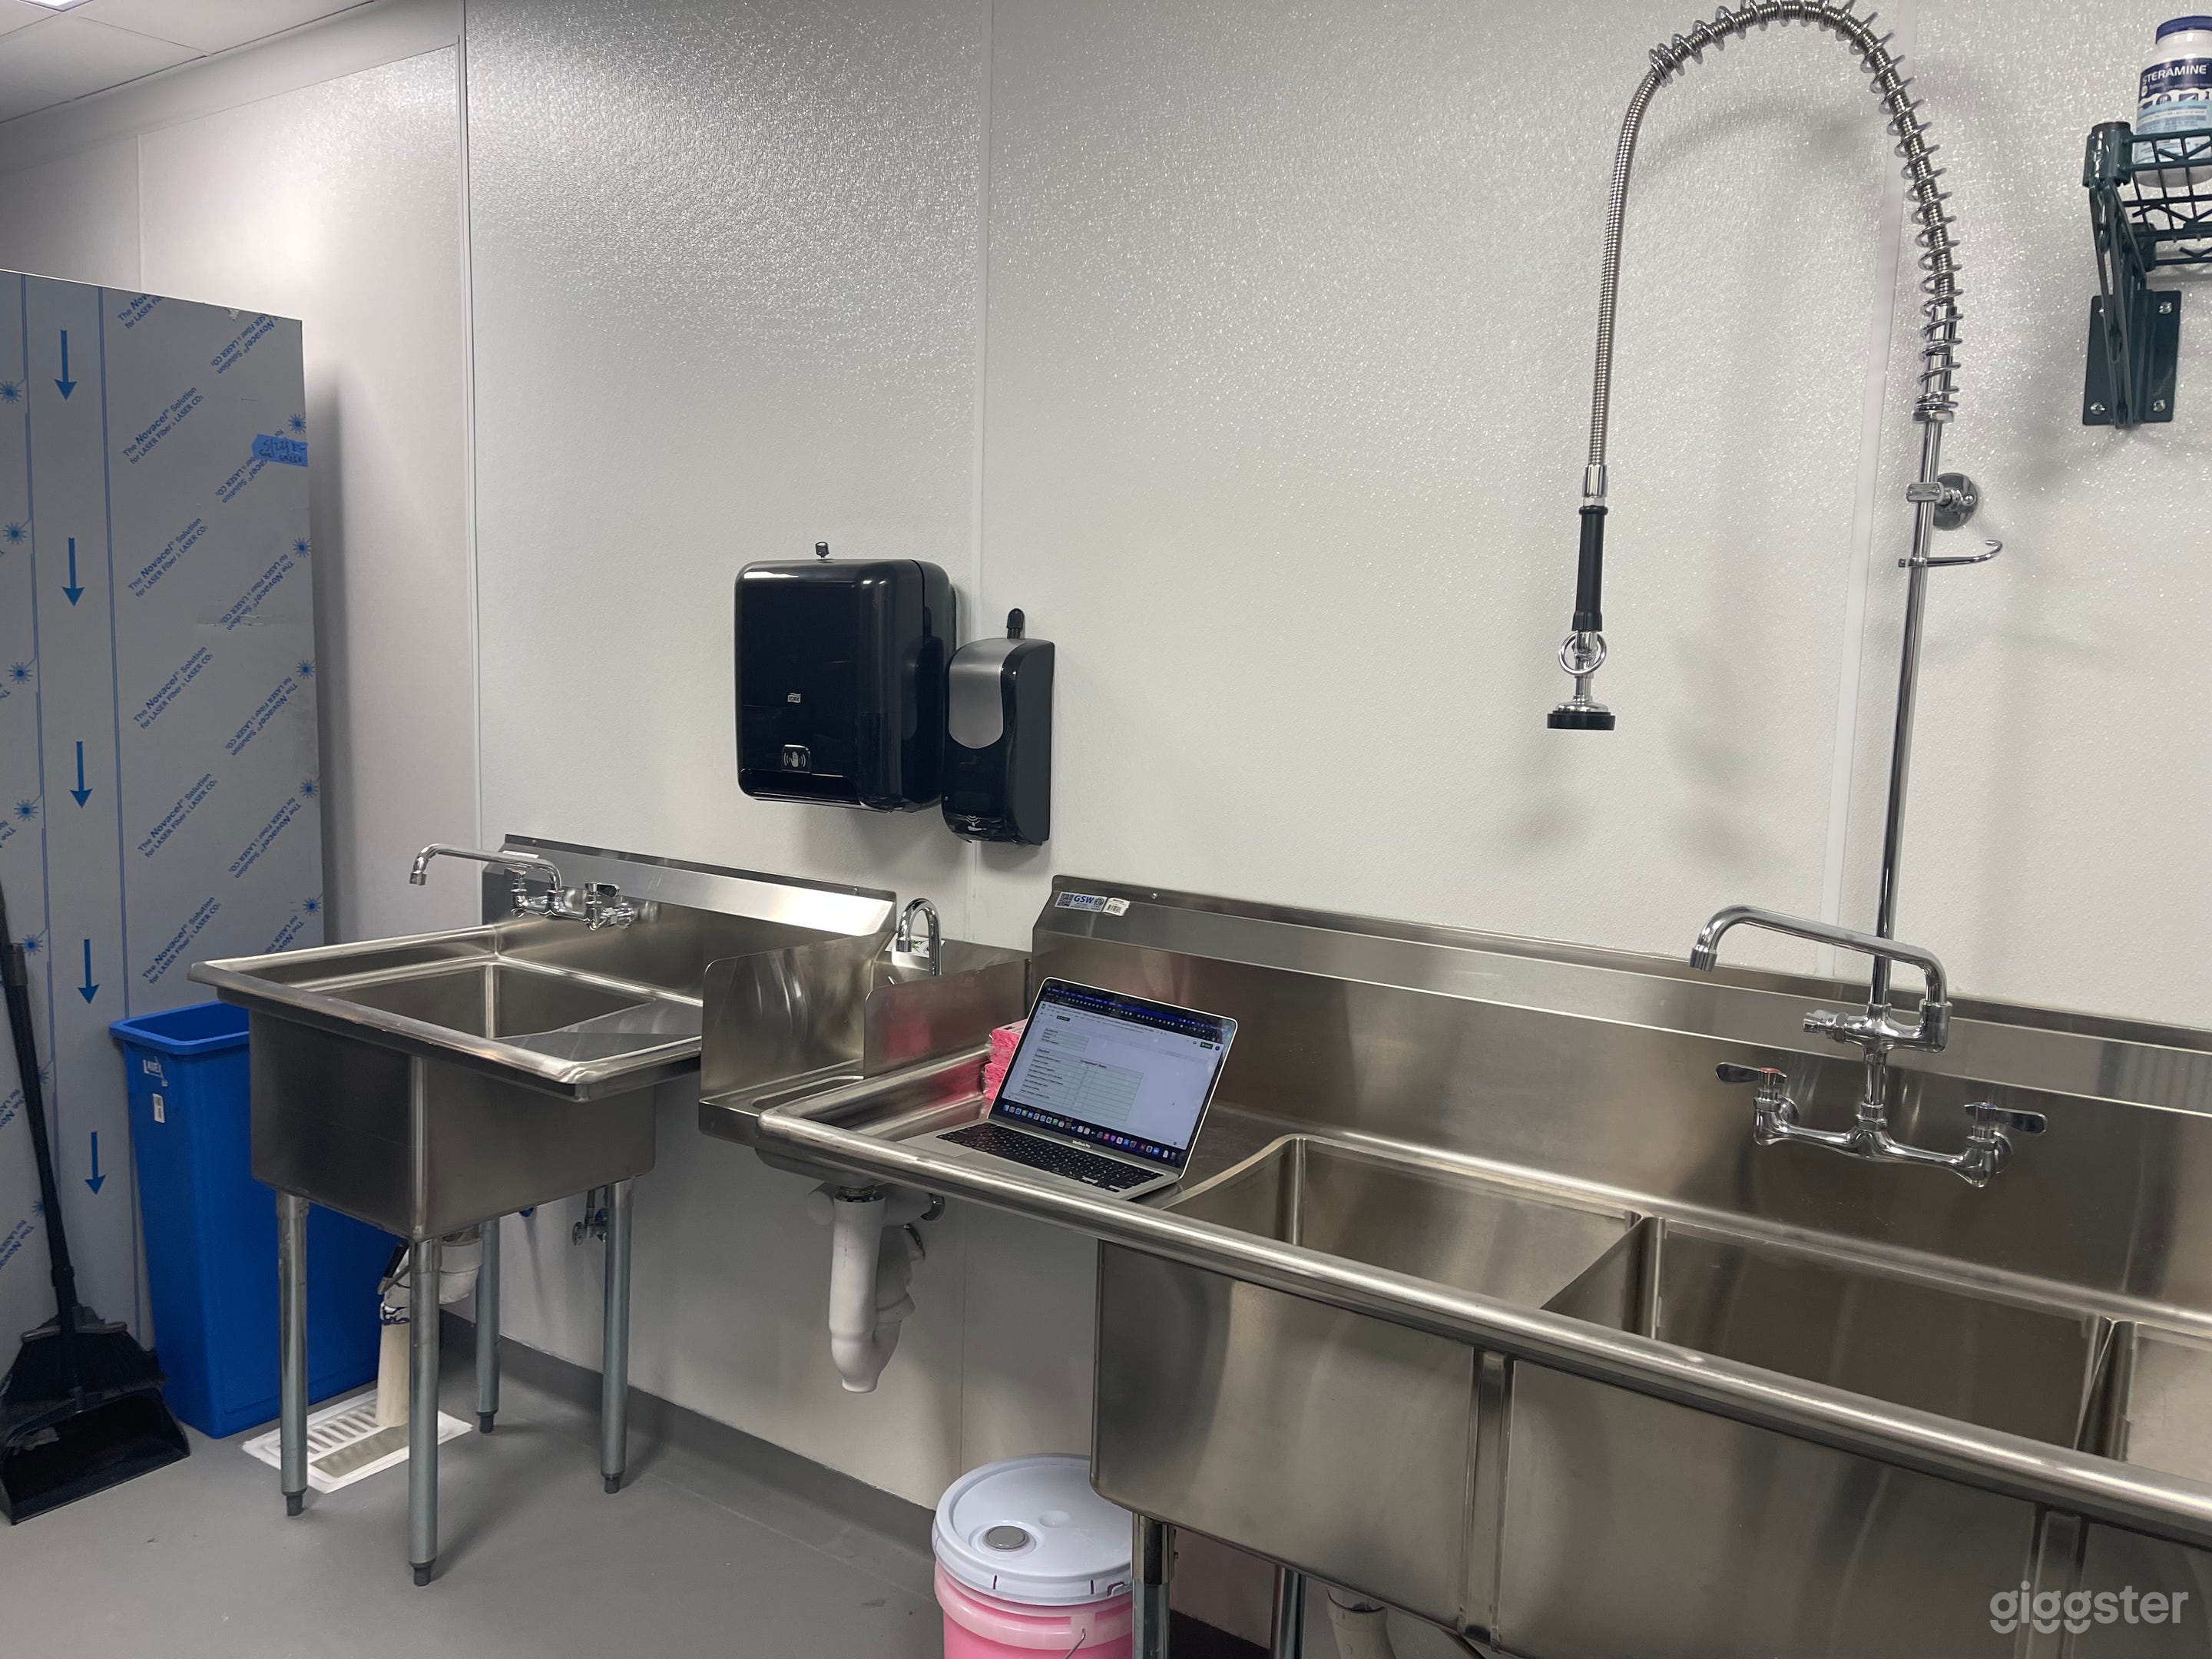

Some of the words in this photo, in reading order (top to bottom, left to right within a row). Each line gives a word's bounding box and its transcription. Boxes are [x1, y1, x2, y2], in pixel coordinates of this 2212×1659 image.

[2142, 65, 2207, 84] STERAMINE
[133, 303, 154, 322] LASER
[220, 339, 240, 358] LASER
[217, 349, 243, 374] Solution
[170, 387, 197, 412] Solution
[137, 437, 158, 456] LASER
[174, 403, 194, 422] LASER
[221, 478, 247, 503] Solution
[224, 469, 244, 487] LASER
[175, 518, 202, 543] Solution
[144, 569, 164, 589] LASER
[178, 535, 198, 554] LASER
[262, 561, 281, 580] LASER
[230, 595, 249, 614] LASER
[180, 647, 207, 674] Solution
[148, 700, 169, 720] LASER
[184, 663, 203, 683] LASER
[267, 684, 285, 704] LASER
[234, 720, 253, 740] LASER
[231, 730, 257, 756] Solution
[184, 773, 211, 800] Solution
[153, 828, 173, 849] LASER
[188, 790, 207, 810] LASER
[270, 805, 288, 825] LASER
[238, 842, 257, 862] LASER
[234, 851, 260, 879] Solution
[188, 896, 215, 925] Solution
[1074, 895, 1095, 904] GSW
[157, 954, 177, 975] LASER
[192, 913, 211, 934] LASER
